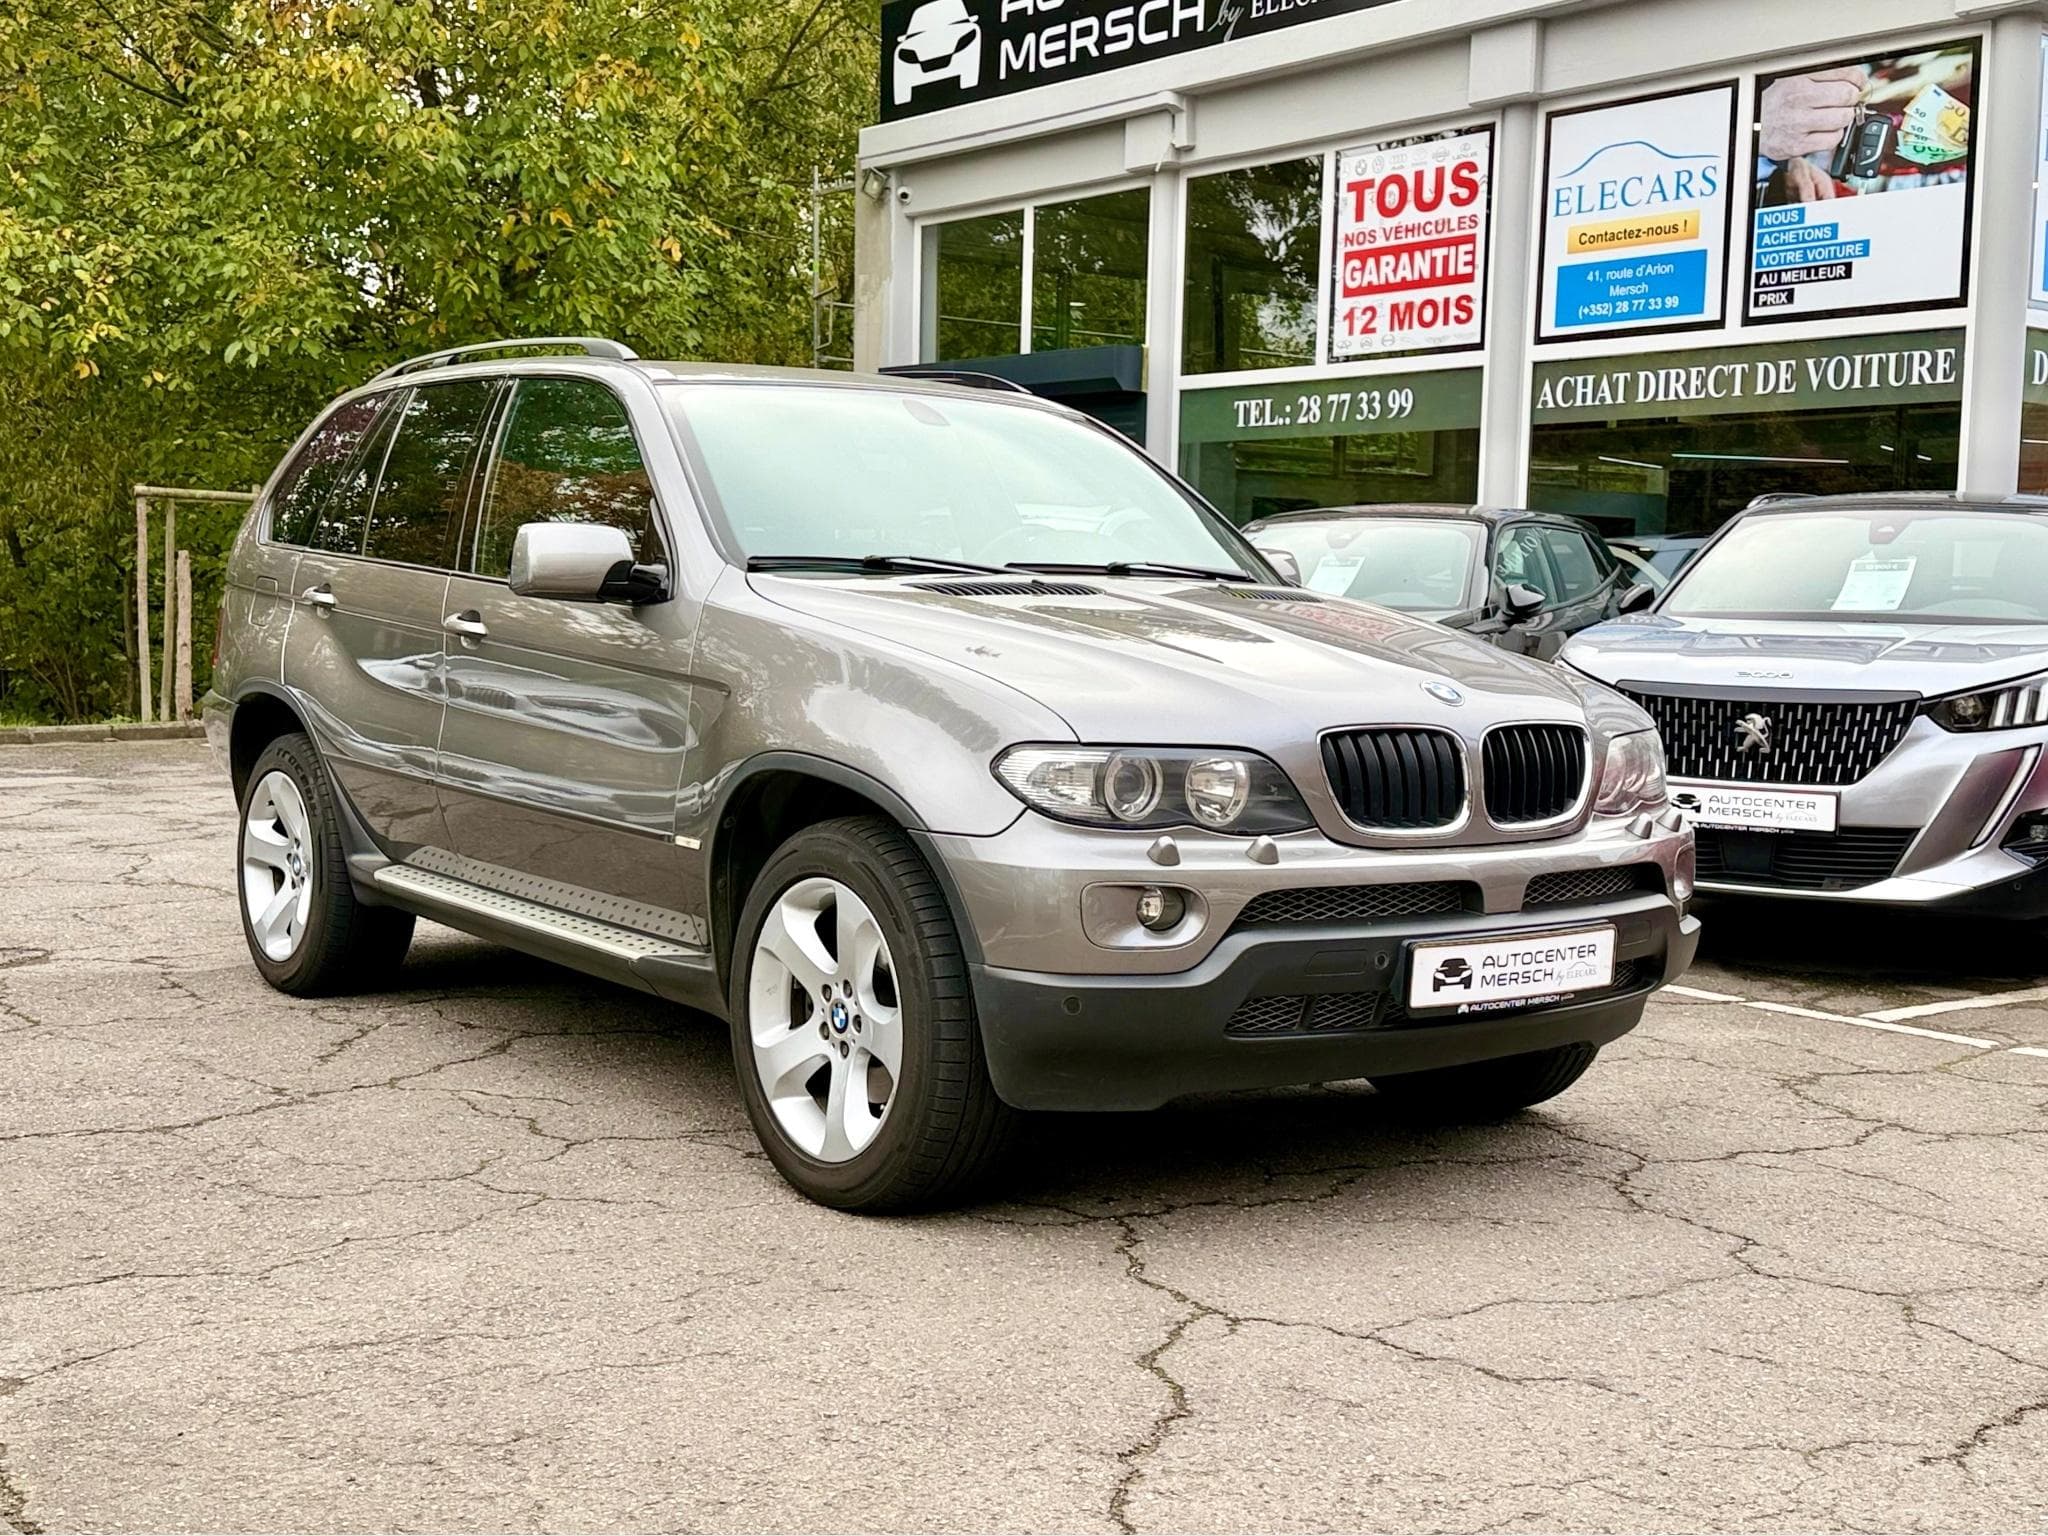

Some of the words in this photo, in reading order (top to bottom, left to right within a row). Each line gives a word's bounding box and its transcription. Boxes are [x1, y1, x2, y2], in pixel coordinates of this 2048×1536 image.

[1000, 0, 1204, 79] MERSCH
[1346, 161, 1479, 223] TOUS
[1553, 165, 1718, 217] ELECARS
[1763, 210, 1799, 226] NOUS
[1344, 229, 1377, 247] NOS
[1382, 213, 1479, 241] VÉHICULES
[1578, 222, 1680, 245] Contactez-nous
[1683, 219, 1688, 232] !
[1761, 226, 1832, 246] ACHETONS
[1345, 243, 1474, 289] GARANTIE
[1760, 249, 1803, 266] VOTRE
[1806, 243, 1864, 261] VOITURE
[1586, 269, 1603, 283] 41,
[1606, 267, 1634, 281] route
[1759, 272, 1778, 286] AU
[1781, 265, 1846, 283] MEILLEUR
[1609, 282, 1649, 297] Mersch
[1758, 291, 1788, 306] PRIX
[1343, 305, 1377, 336] 12
[1389, 294, 1474, 332] MOIS
[1578, 302, 1613, 320] (+352)
[1615, 301, 1630, 314] 28
[1632, 299, 1646, 311] 77
[1648, 297, 1662, 310] 33
[1664, 295, 1680, 309] 99
[1536, 372, 1631, 409] ACHAT
[1635, 363, 1749, 403] DIRECT
[1754, 359, 1797, 396] DE
[1805, 348, 1956, 392] VOITURE
[1234, 397, 1291, 428] TEL.:
[1296, 395, 1321, 424] 28
[1327, 392, 1351, 422] 77
[1355, 390, 1381, 421] 33
[1386, 388, 1414, 419] 99
[1708, 795, 1816, 810] AUTOCENTER
[1708, 806, 1773, 818] MERSCH
[1700, 823, 1748, 832] AUTOCENTER
[1748, 826, 1779, 834] MERSCH
[1482, 944, 1597, 969] AUTOCENTER
[1480, 968, 1554, 989] MERSCH
[1566, 968, 1597, 980] ELECARS
[1470, 998, 1527, 1012] AUTOCENTER
[1527, 995, 1560, 1006] MERSCH
